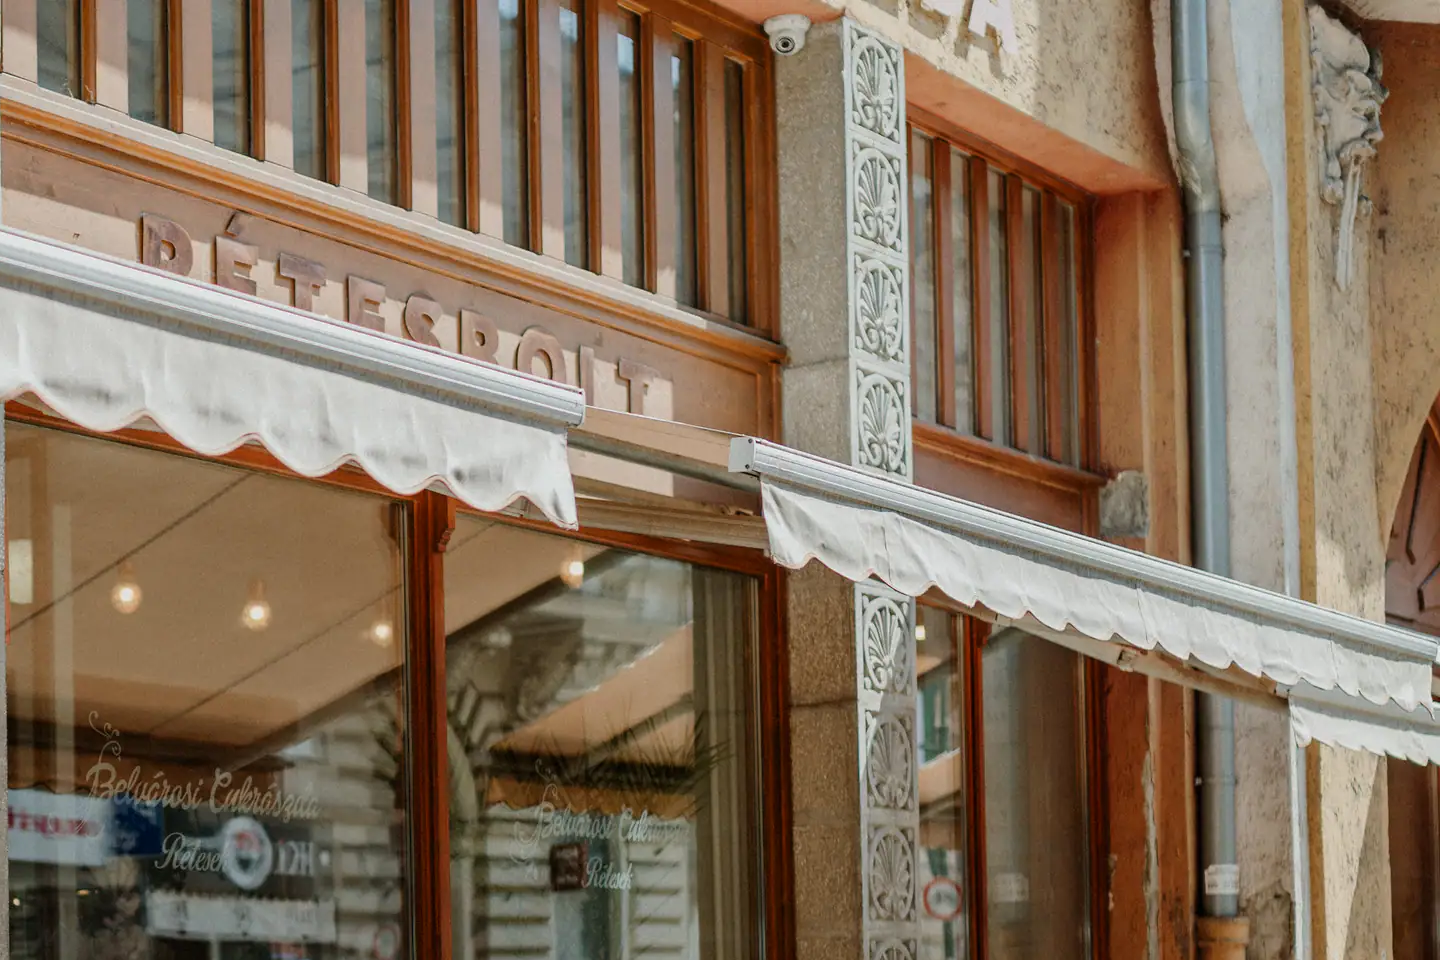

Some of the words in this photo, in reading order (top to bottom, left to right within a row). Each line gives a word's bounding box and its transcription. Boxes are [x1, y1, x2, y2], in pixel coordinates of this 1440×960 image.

[85, 762, 204, 812] Belvárosi
[210, 767, 321, 823] Cukrászda
[535, 801, 614, 839] Belvárosi
[154, 832, 229, 872] Rétesek
[581, 857, 633, 890] Rétesek
